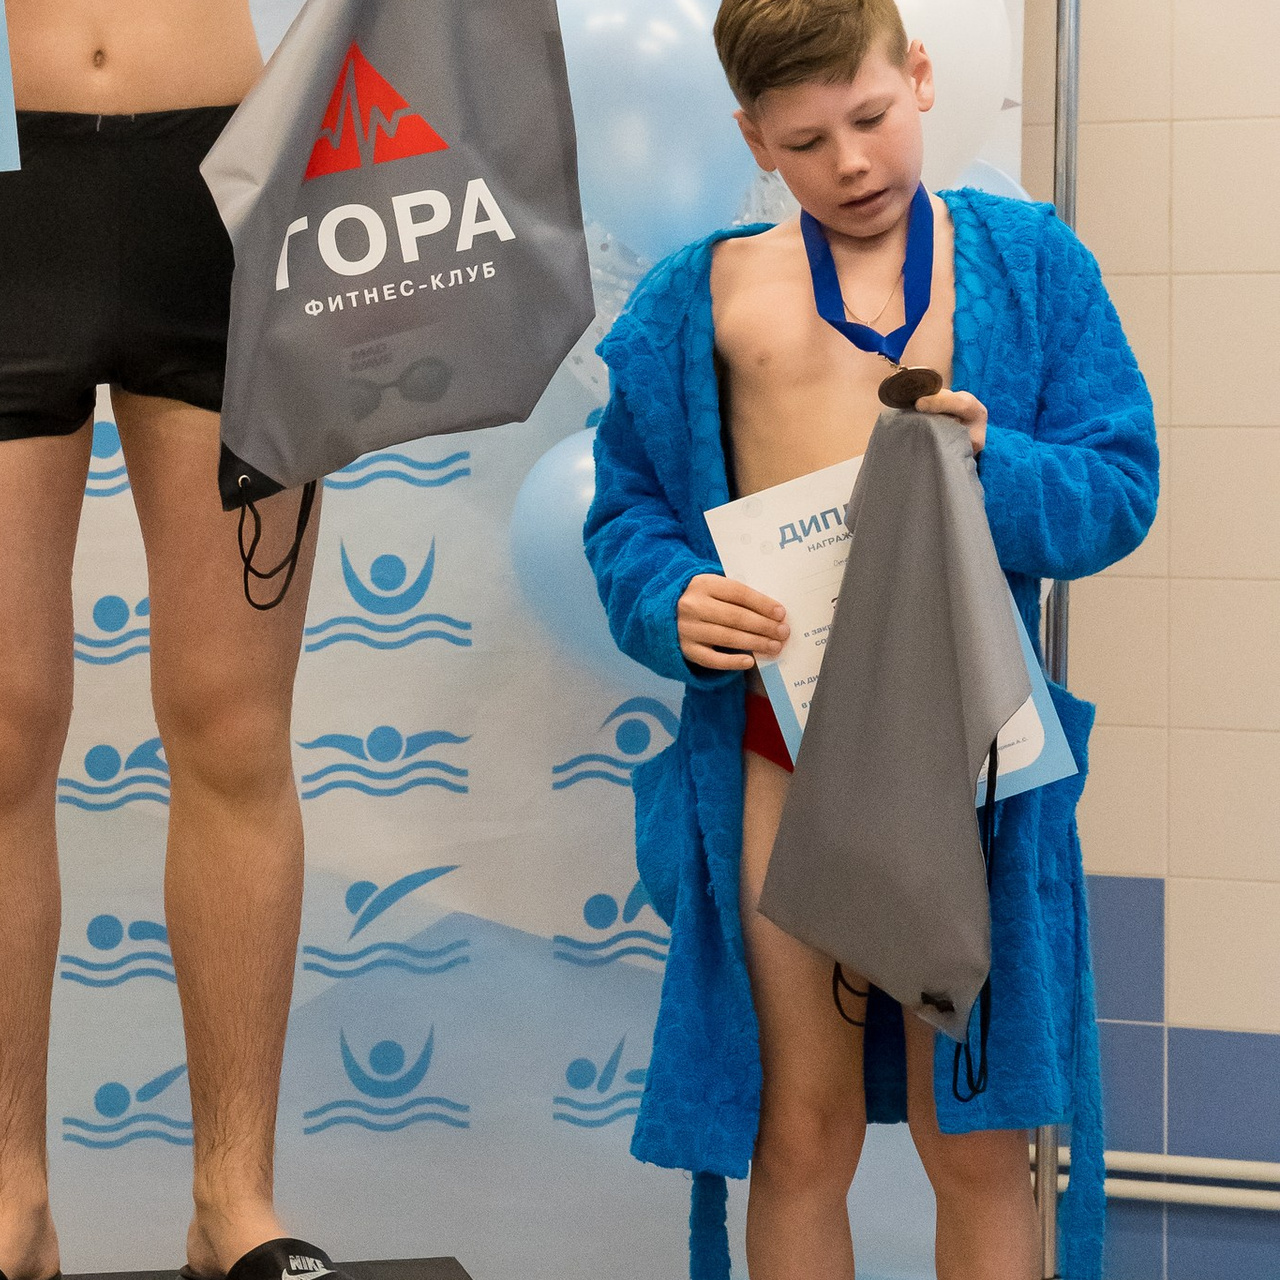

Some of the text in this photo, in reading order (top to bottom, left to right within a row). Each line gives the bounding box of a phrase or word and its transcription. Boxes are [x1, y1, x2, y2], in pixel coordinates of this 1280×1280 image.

[275, 177, 516, 291] ГОРА
[304, 261, 496, 316] ФИТНЕС-КЛУБ
[779, 504, 848, 549] ДИП
[289, 1255, 326, 1271] NIKE
